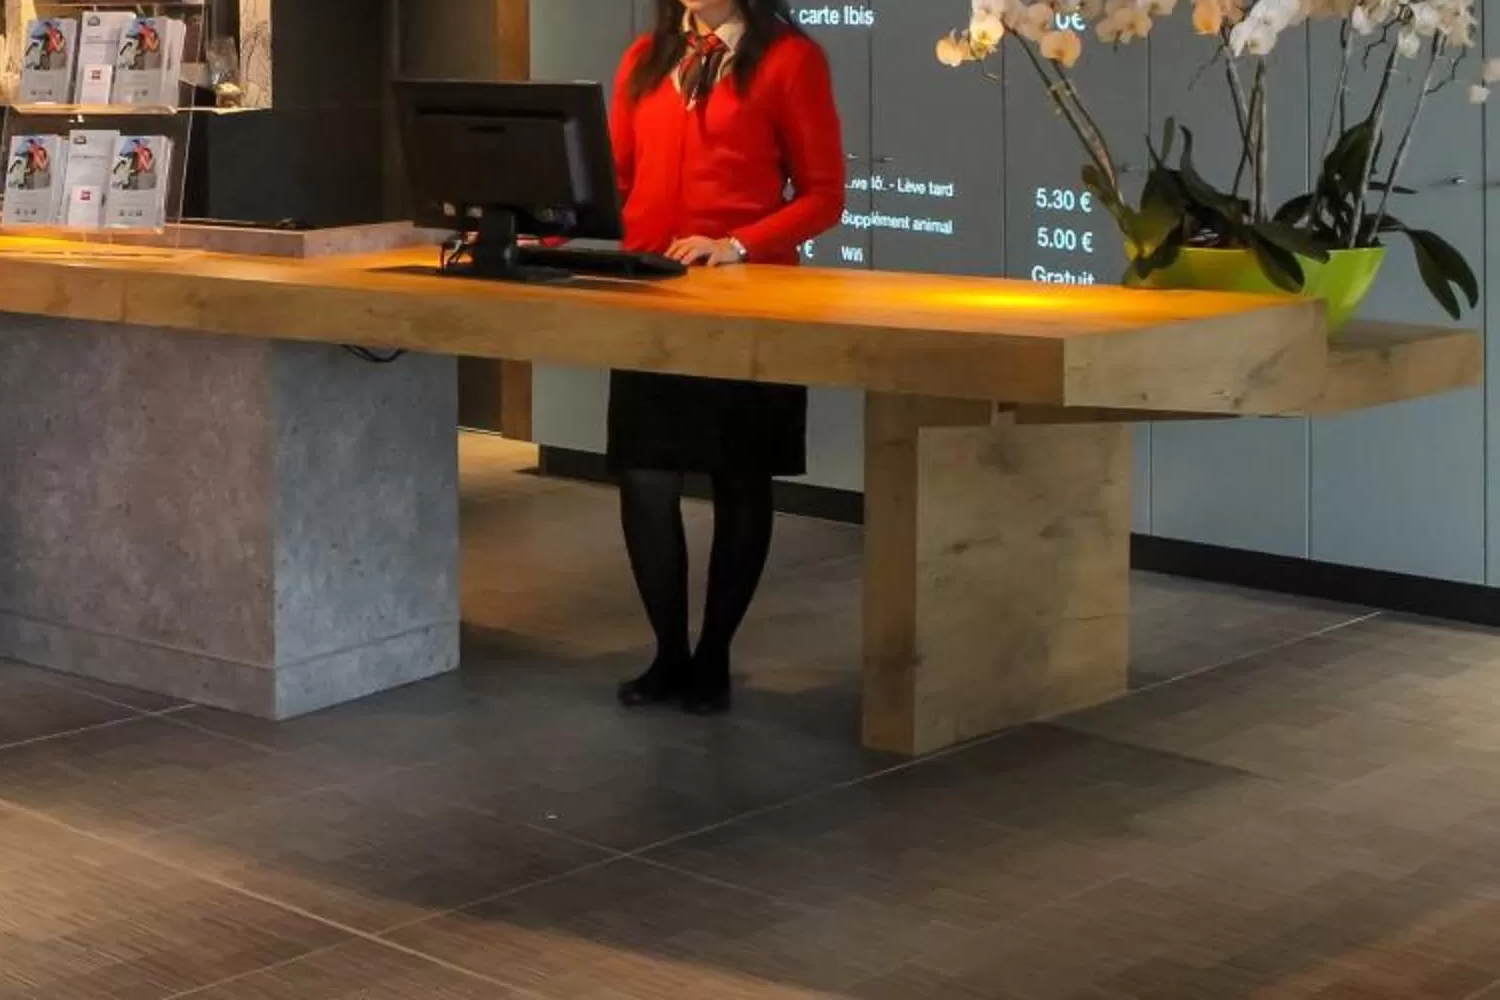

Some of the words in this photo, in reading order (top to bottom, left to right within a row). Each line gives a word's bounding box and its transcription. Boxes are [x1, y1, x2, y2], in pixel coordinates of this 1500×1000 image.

[798, 6, 840, 26] carte
[843, 5, 875, 26] Ibis
[1036, 187, 1075, 211] 5.30
[912, 218, 953, 235] animal
[1037, 226, 1077, 251] 5.00
